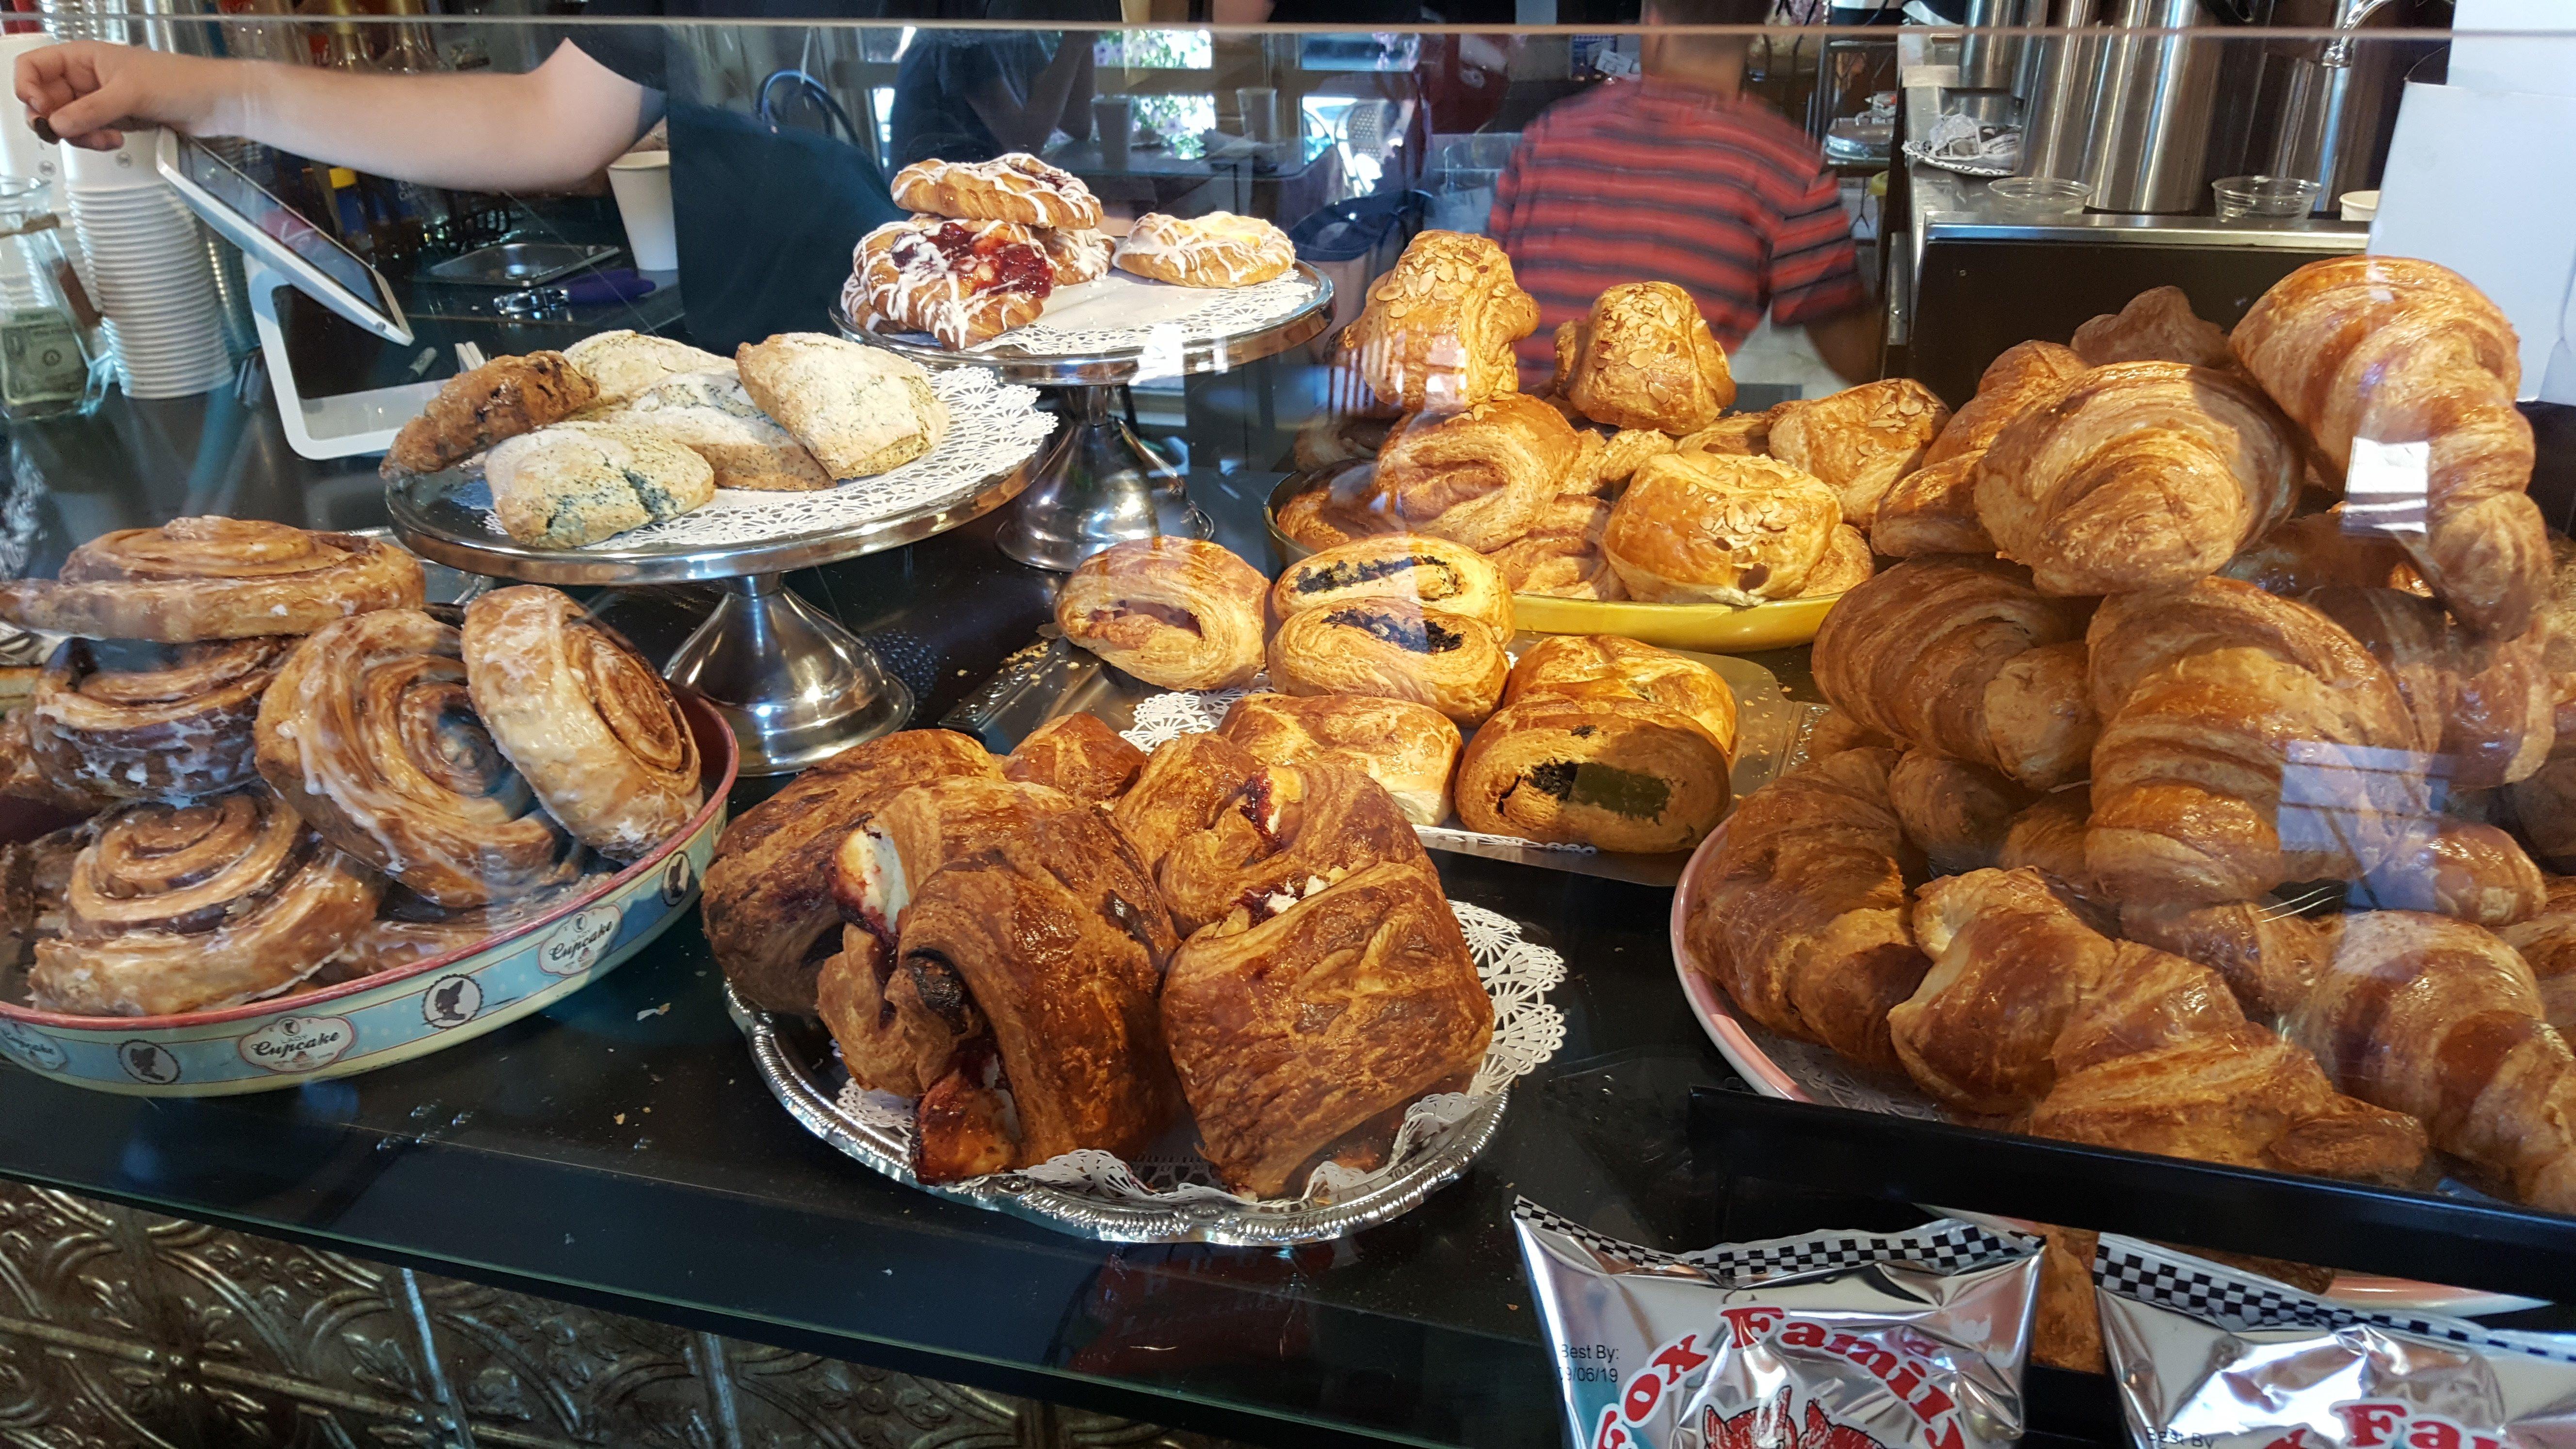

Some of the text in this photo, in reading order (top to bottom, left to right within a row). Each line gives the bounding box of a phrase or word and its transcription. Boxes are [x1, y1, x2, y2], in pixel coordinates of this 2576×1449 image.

[549, 921, 612, 961] Cupcake
[250, 1032, 339, 1058] Cupcake
[1561, 1344, 1620, 1364] Best By:
[1597, 1307, 1965, 1449] Fox Family
